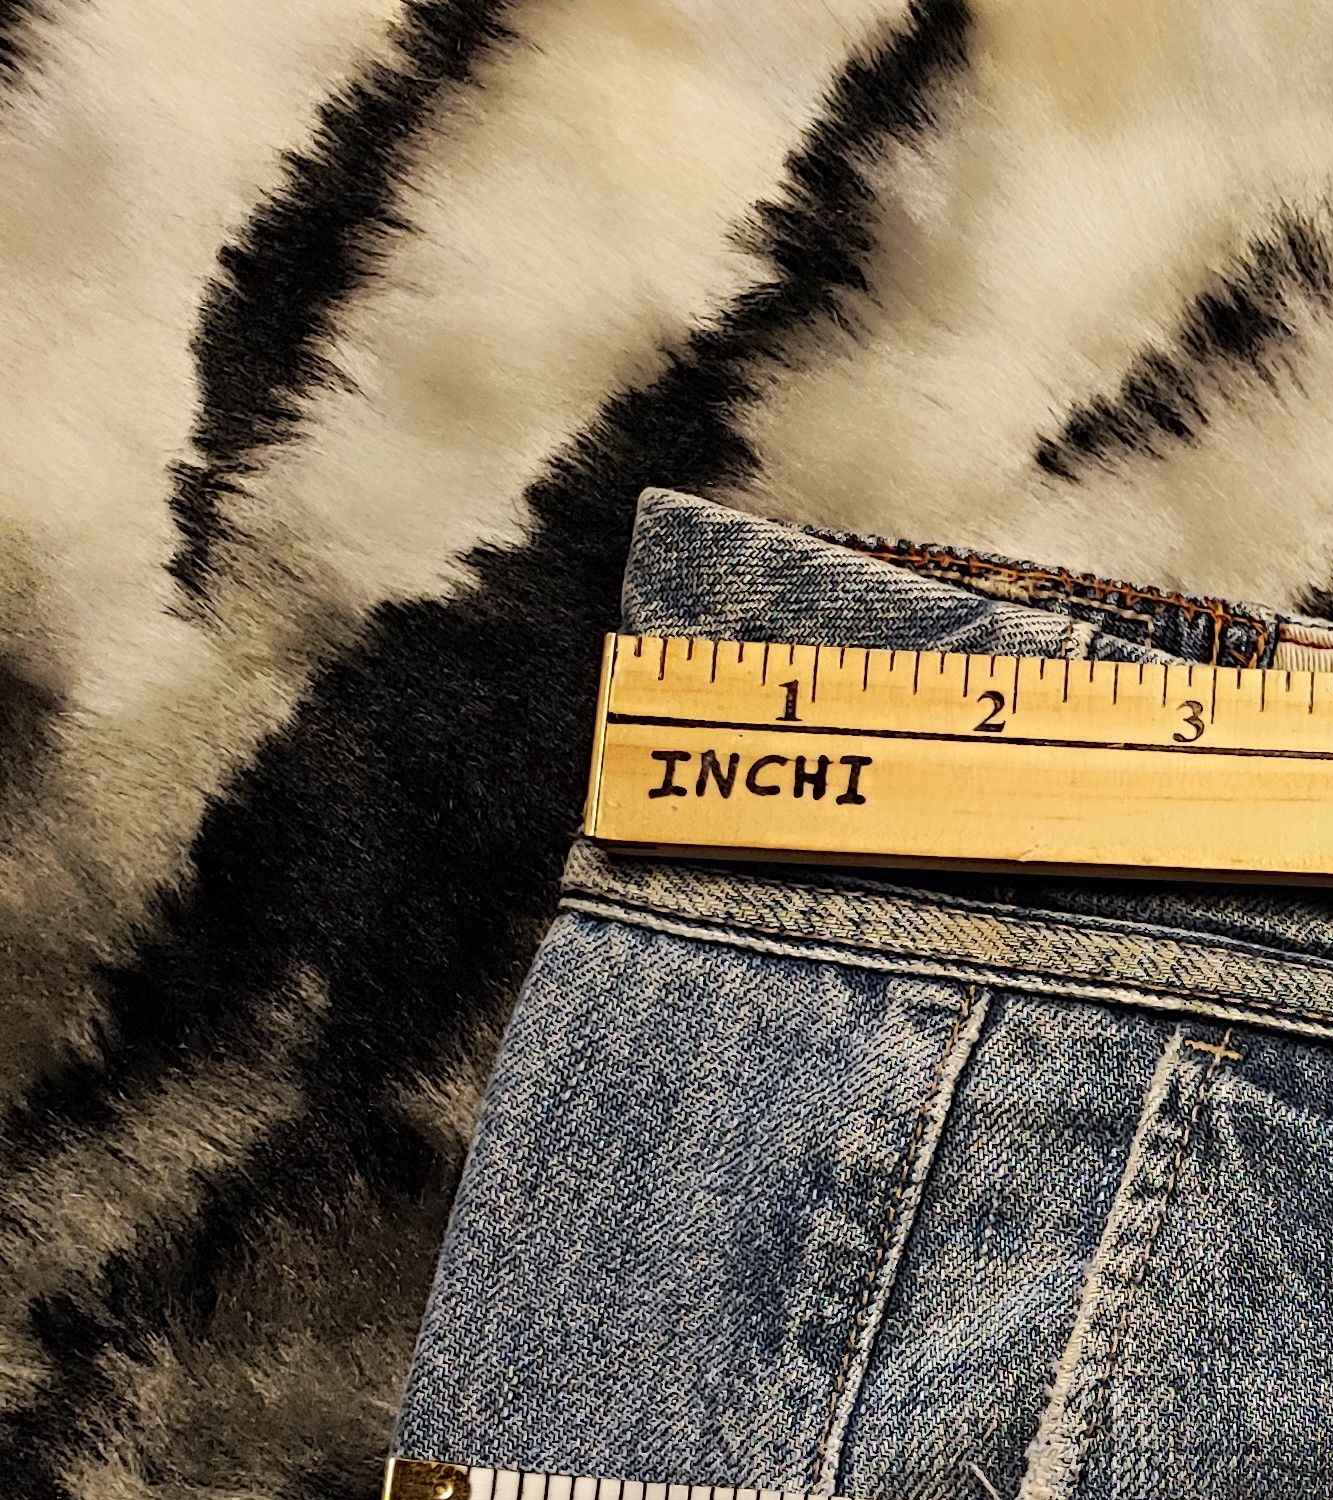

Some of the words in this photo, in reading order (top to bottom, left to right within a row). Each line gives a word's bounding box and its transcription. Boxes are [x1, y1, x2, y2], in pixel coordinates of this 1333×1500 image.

[777, 680, 802, 721] 1
[974, 691, 1006, 733] 2
[1173, 701, 1205, 743] 3
[649, 749, 873, 805] INCHI
